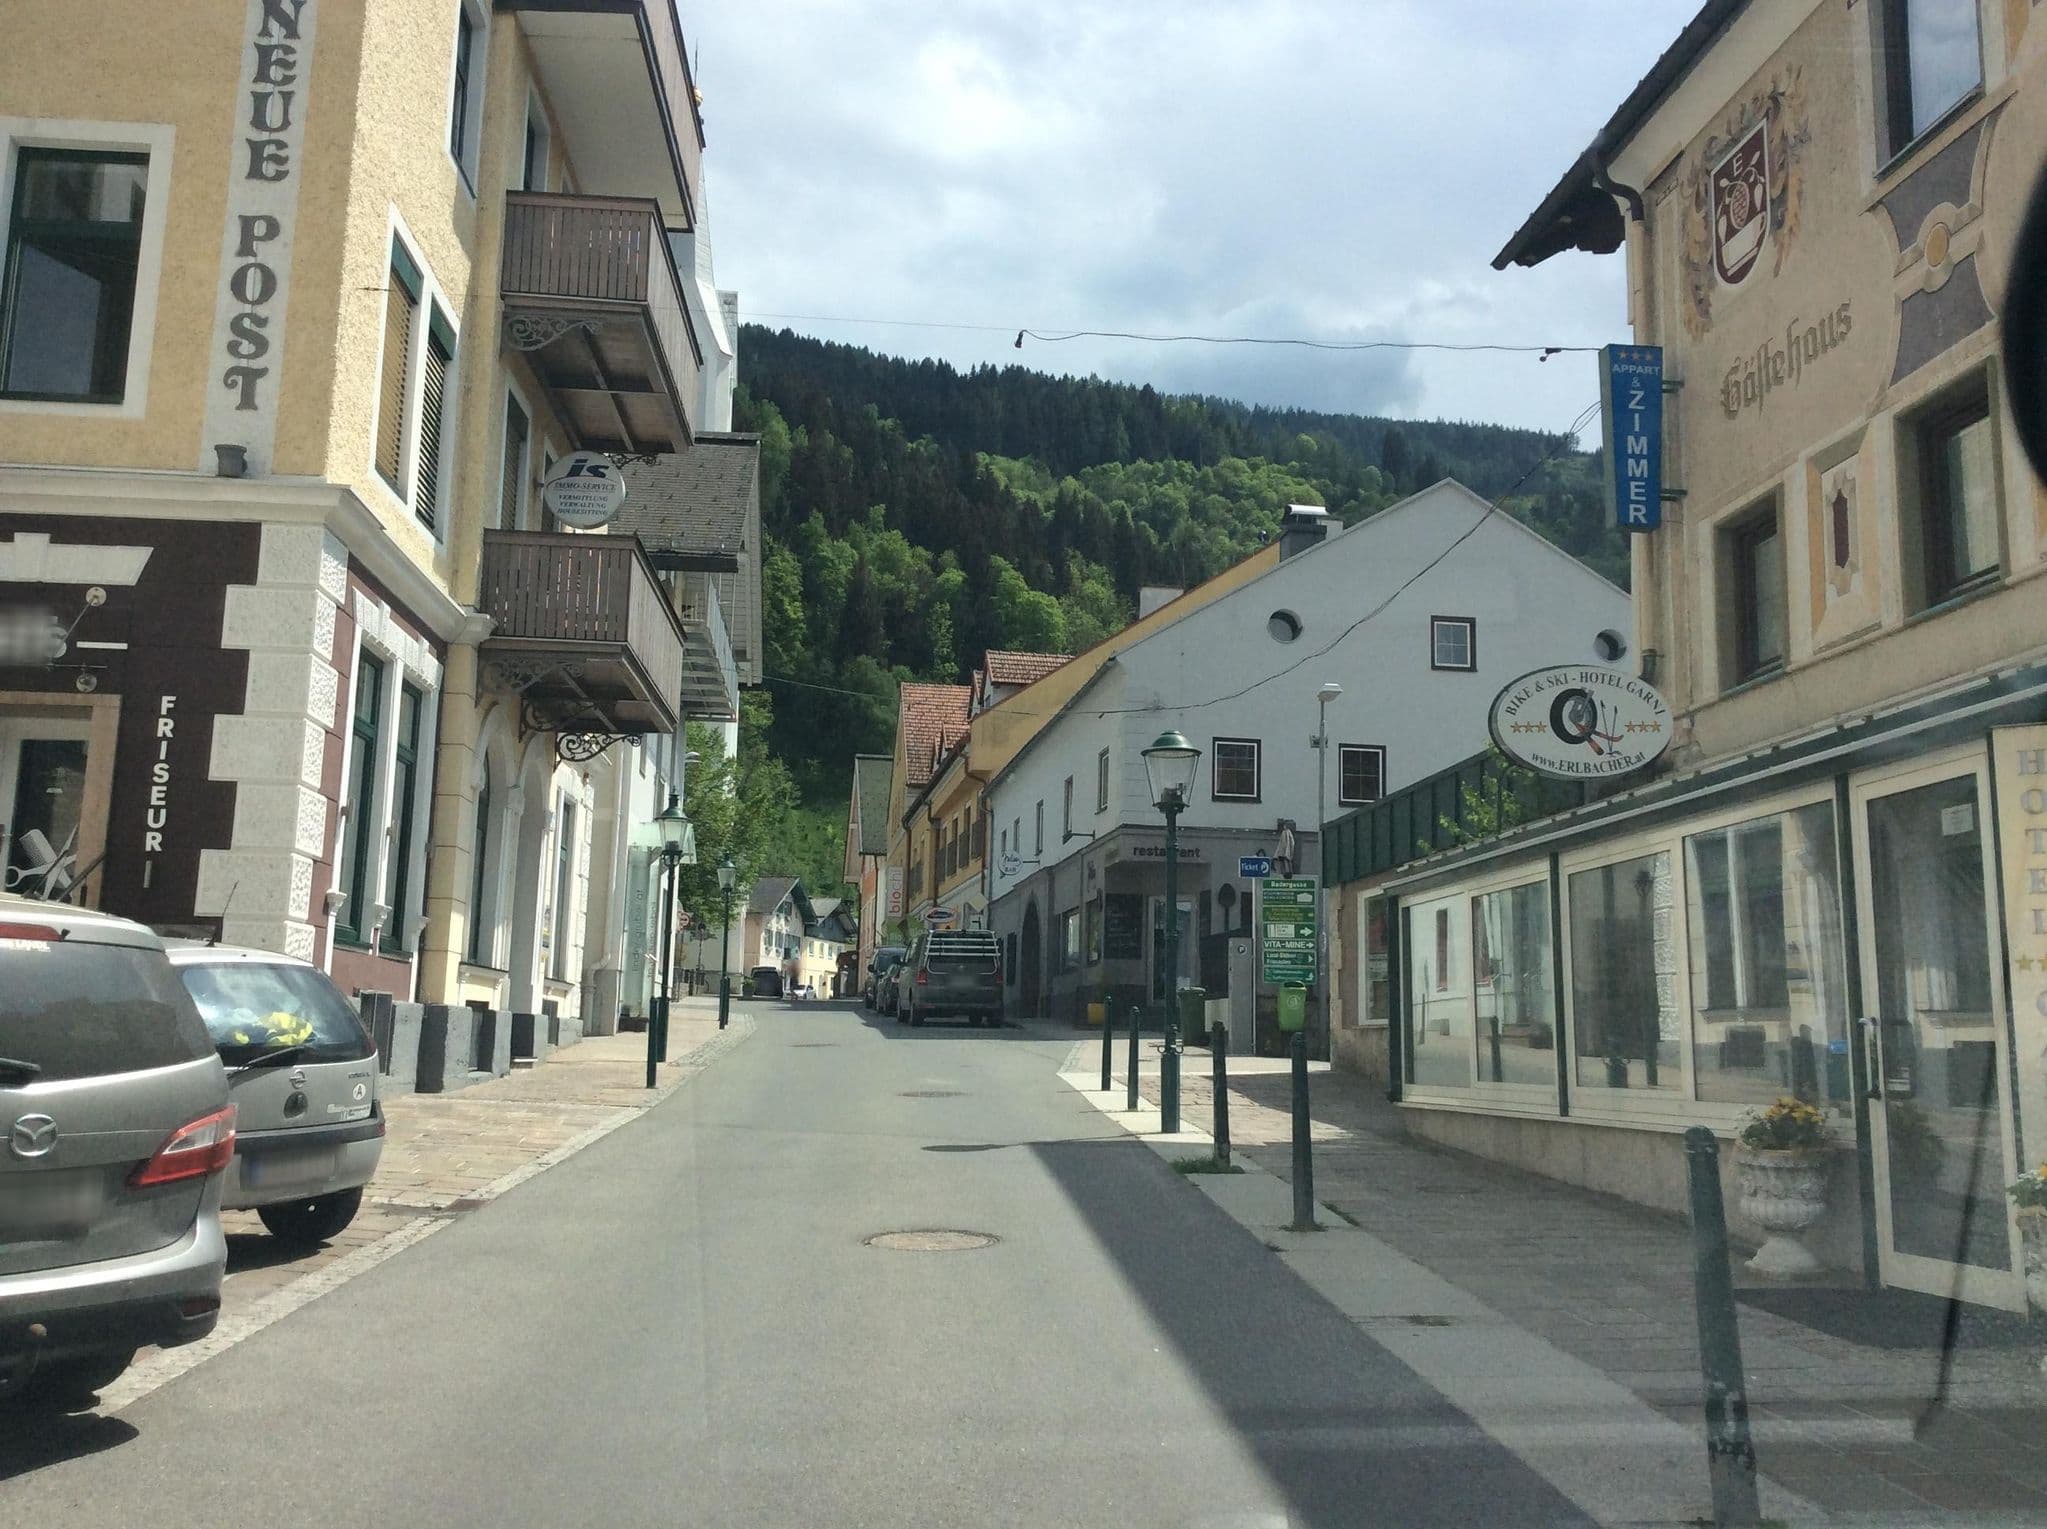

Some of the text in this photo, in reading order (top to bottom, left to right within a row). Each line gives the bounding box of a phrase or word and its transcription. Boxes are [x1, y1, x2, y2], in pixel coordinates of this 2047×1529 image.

[244, 0, 301, 182] NEUE
[223, 215, 281, 411] POST
[1612, 363, 1660, 376] APPART
[1631, 377, 1641, 388] &
[1626, 390, 1648, 524] ZIMMER
[554, 481, 616, 491] IMMO-SERVICE
[559, 501, 607, 509] VERWALTUNG
[1505, 686, 1534, 716] BIKE
[1534, 680, 1545, 693] &
[1546, 672, 1569, 687] SKI
[1579, 671, 1624, 689] HOTEL
[1626, 681, 1667, 716] GARNI
[145, 695, 177, 852] FRISEUR
[1532, 751, 1646, 774] www.ERLBACHER.at
[1264, 941, 1306, 949] VITA-MINE
